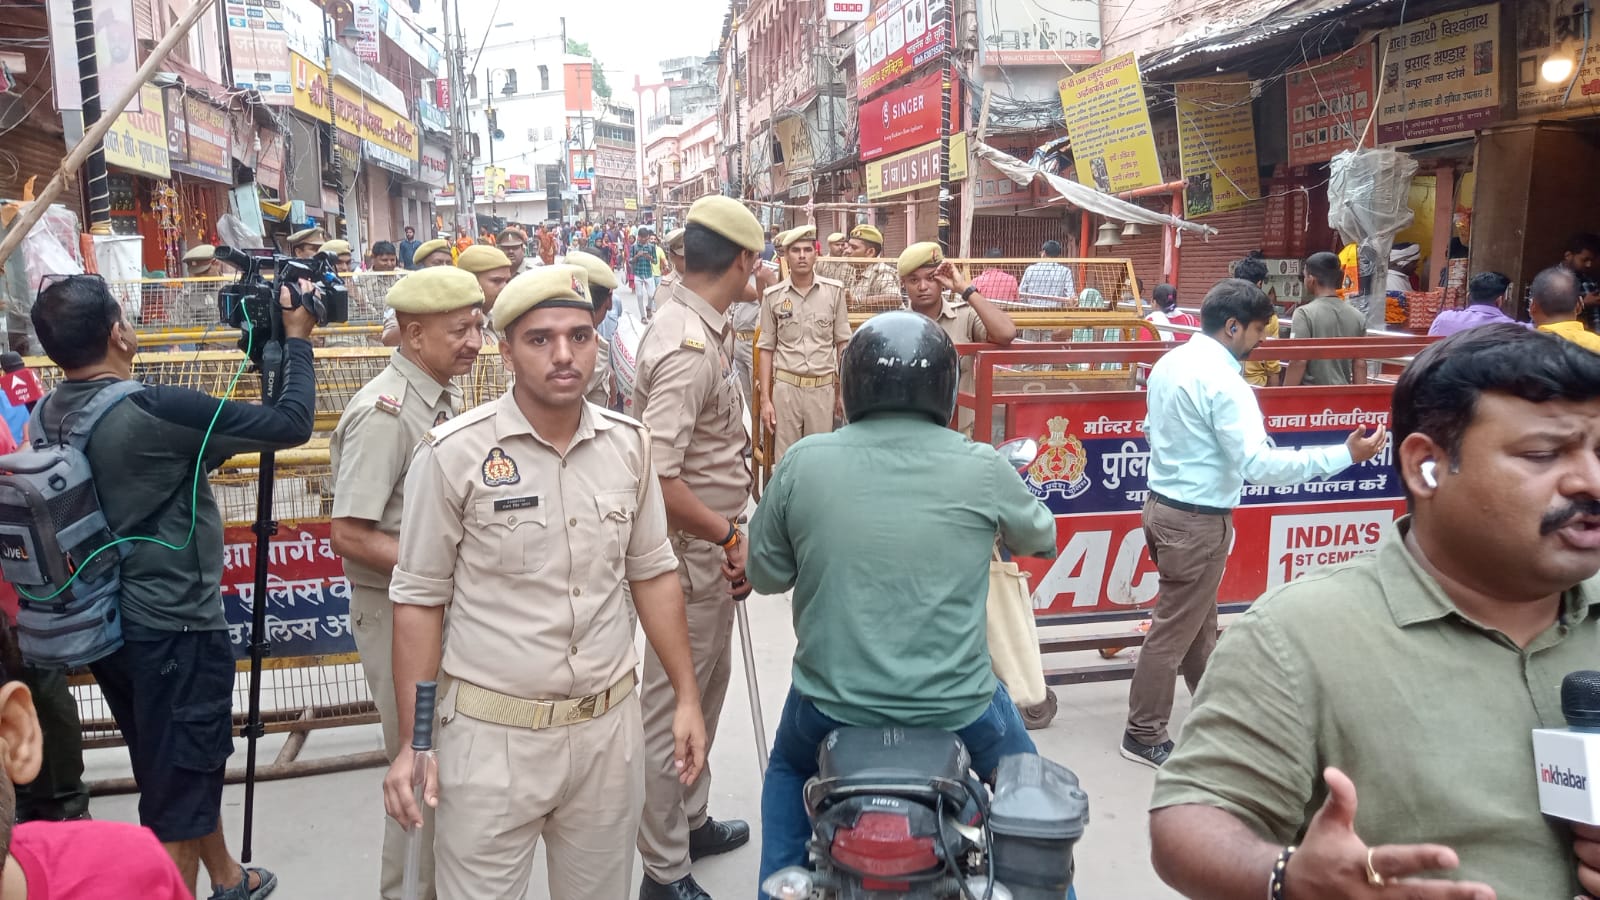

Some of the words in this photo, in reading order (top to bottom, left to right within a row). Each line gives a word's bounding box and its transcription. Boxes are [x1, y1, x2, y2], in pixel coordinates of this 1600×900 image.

[834, 3, 863, 13] USHA
[1410, 22, 1437, 46] काशी
[1442, 13, 1489, 37] विश्वनाथ
[1404, 53, 1432, 74] प्रसाद
[1434, 45, 1468, 66] भण्डार
[893, 95, 924, 119] SINGER
[1434, 93, 1443, 107] की
[901, 153, 940, 181] USHA
[267, 371, 275, 397] SONY
[1083, 416, 1133, 435] मन्दिर
[1268, 414, 1307, 429] जाना
[1310, 408, 1390, 429] प्रतिबन्धित
[1101, 441, 1148, 490] पुलि
[1303, 479, 1355, 494] पालन
[1358, 474, 1387, 492] करें
[1286, 522, 1380, 550] INDIA'S
[1540, 763, 1586, 791] inkhabar
